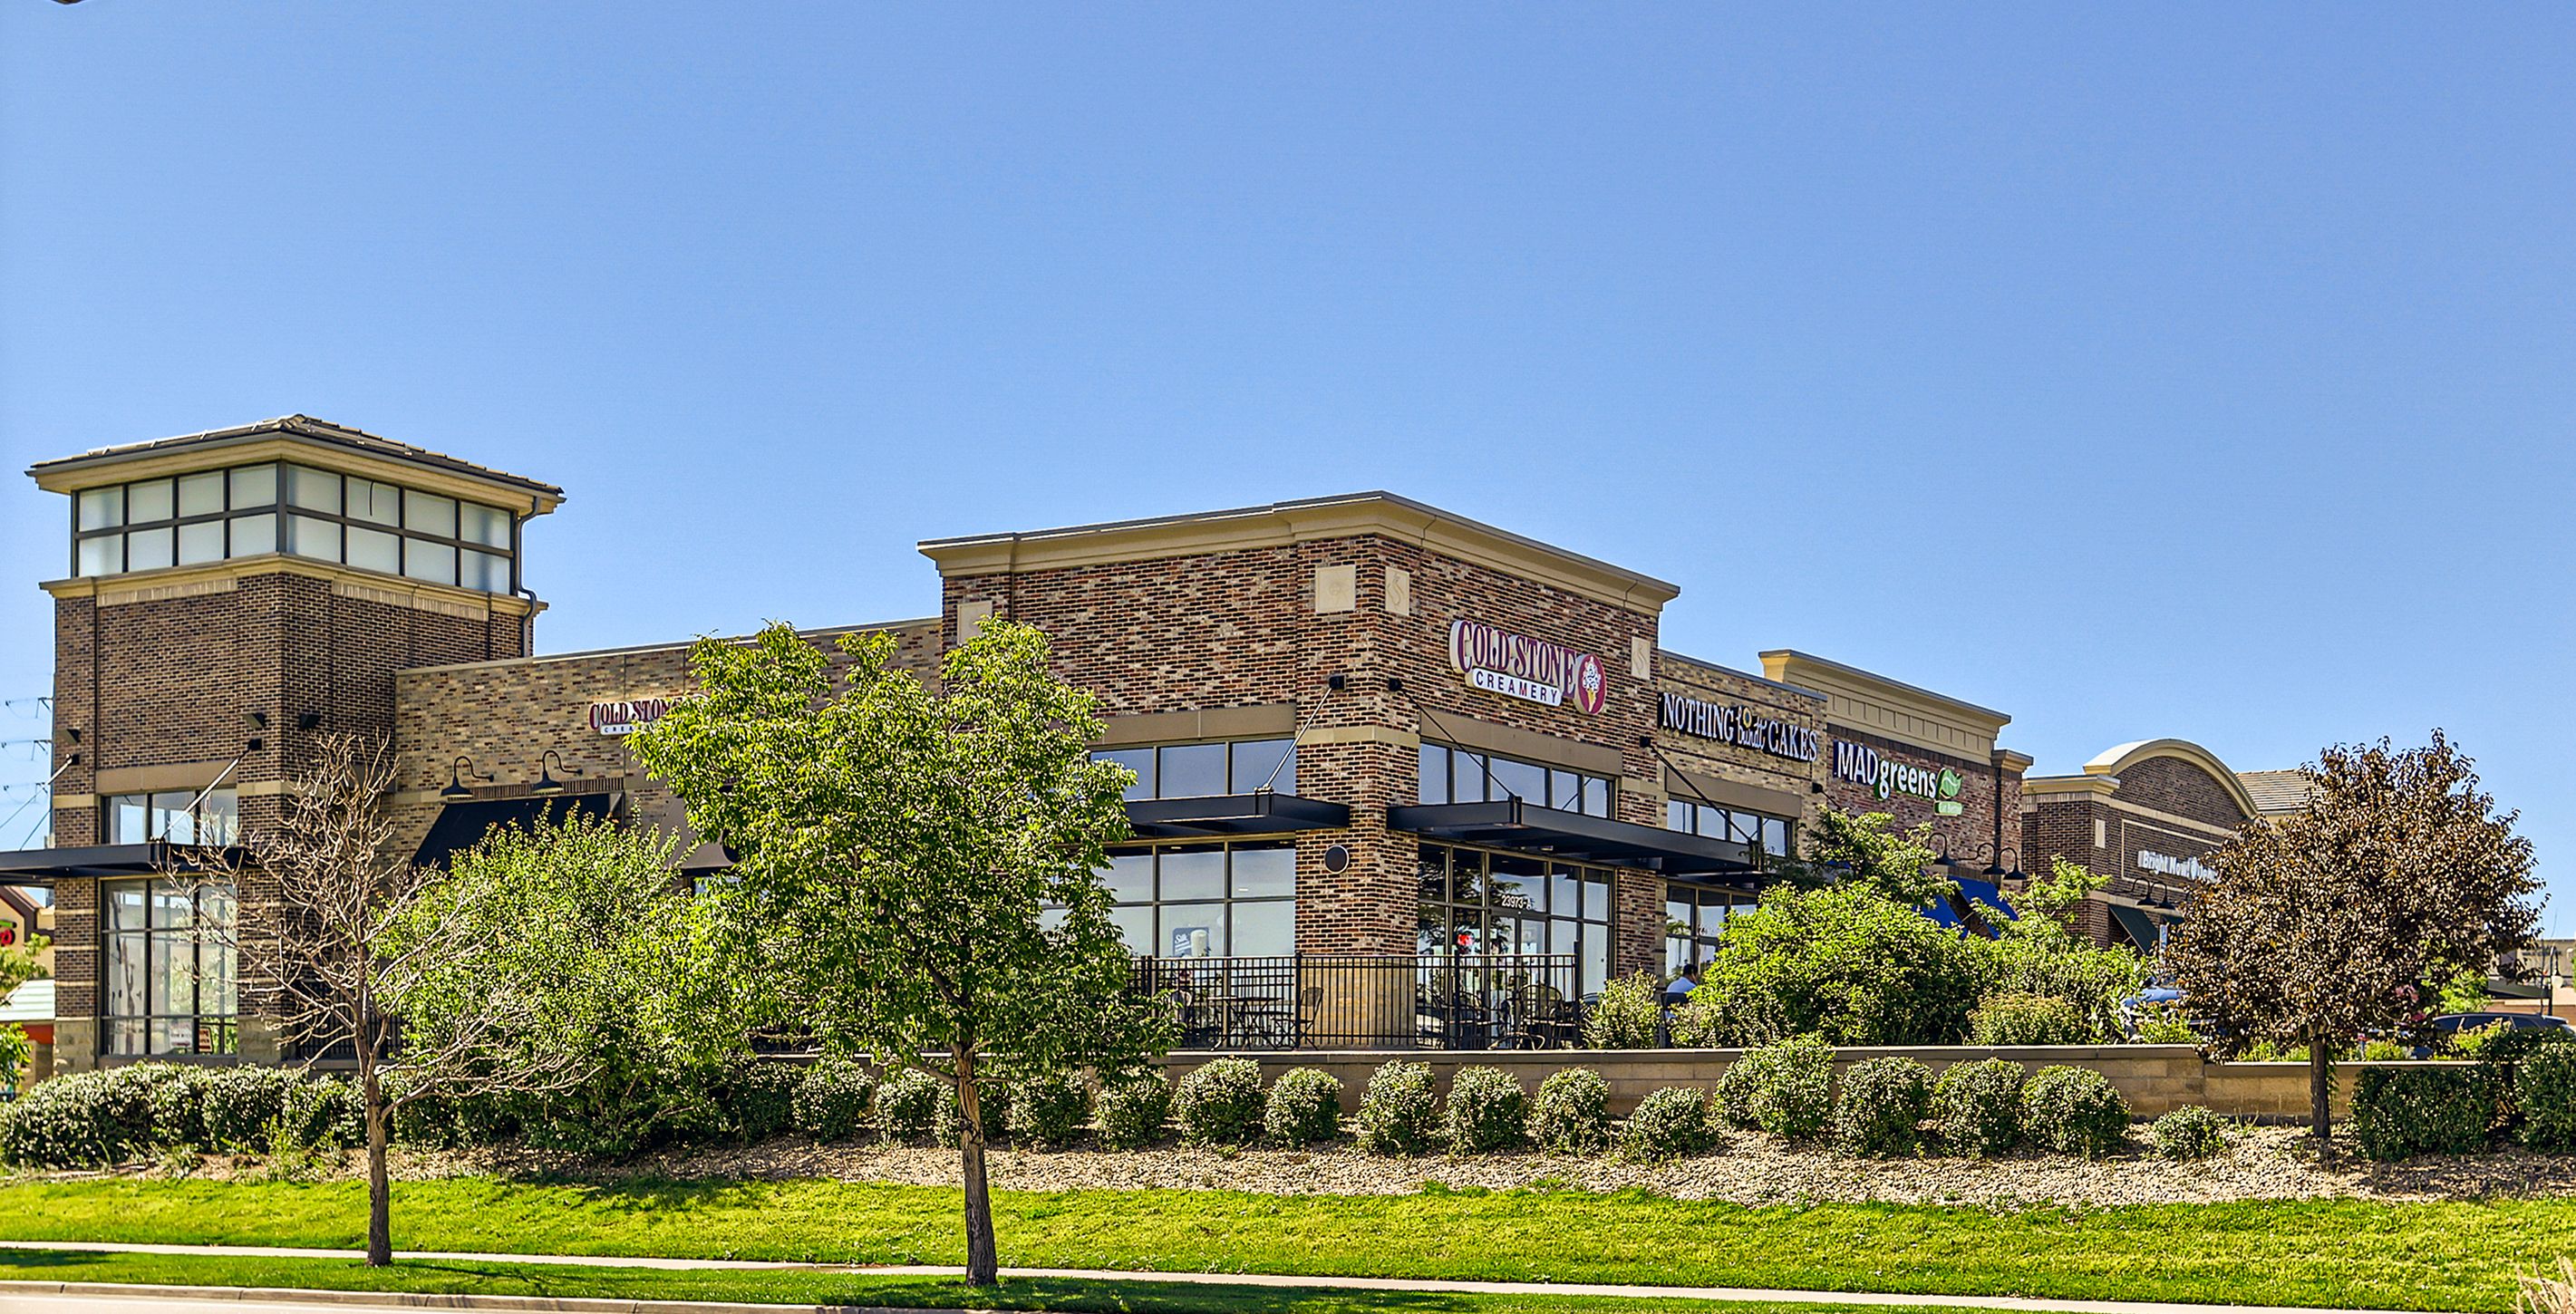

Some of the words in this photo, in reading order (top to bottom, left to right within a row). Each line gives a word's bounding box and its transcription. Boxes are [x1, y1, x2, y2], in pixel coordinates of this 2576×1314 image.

[1456, 620, 1510, 673] COLD
[1514, 634, 1577, 698] STONE
[1476, 671, 1558, 704] CREAMERY
[589, 701, 629, 730] COLD
[604, 725, 634, 733] CREA
[1662, 692, 1735, 741] NOTHING
[1768, 720, 1818, 762] CAKES
[2141, 850, 2169, 875] Bright
